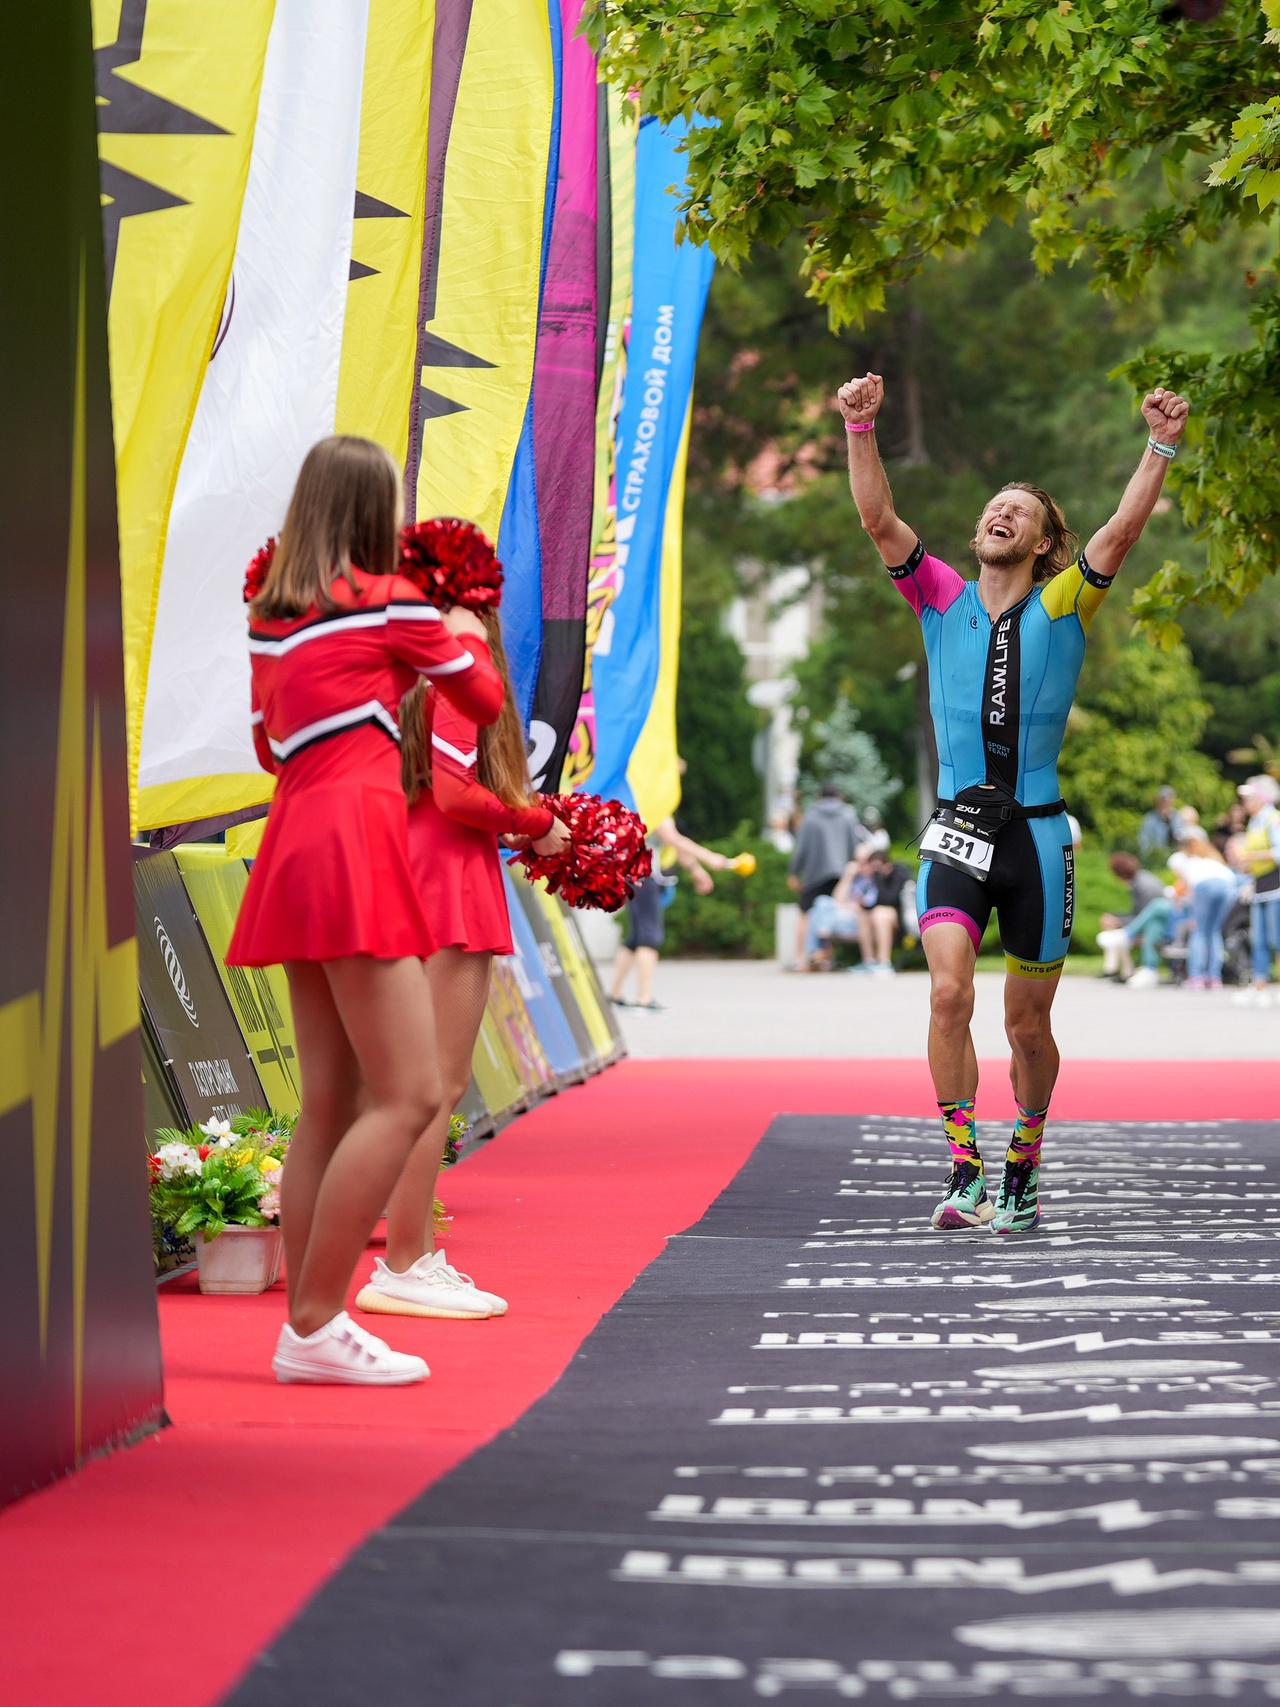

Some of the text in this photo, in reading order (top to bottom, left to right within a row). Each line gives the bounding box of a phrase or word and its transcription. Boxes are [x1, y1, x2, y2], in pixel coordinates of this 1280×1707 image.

[622, 304, 675, 512] СТРАХОВОЙ ДОМ
[989, 618, 1012, 726] R.A.W.LIFE
[987, 741, 1011, 754] SPORT
[987, 747, 1008, 758] TEAM
[955, 804, 981, 815] 2XU
[938, 832, 975, 860] 521
[1064, 850, 1073, 929] R.A.W.LIFE
[921, 911, 955, 925] ENERGY
[1020, 964, 1045, 974] NUTS
[786, 1274, 1013, 1286] IRON
[759, 1333, 1019, 1345] IRON
[719, 1405, 1022, 1420] IRON
[656, 1494, 1022, 1520] IRON
[620, 1550, 1024, 1584] IRON
